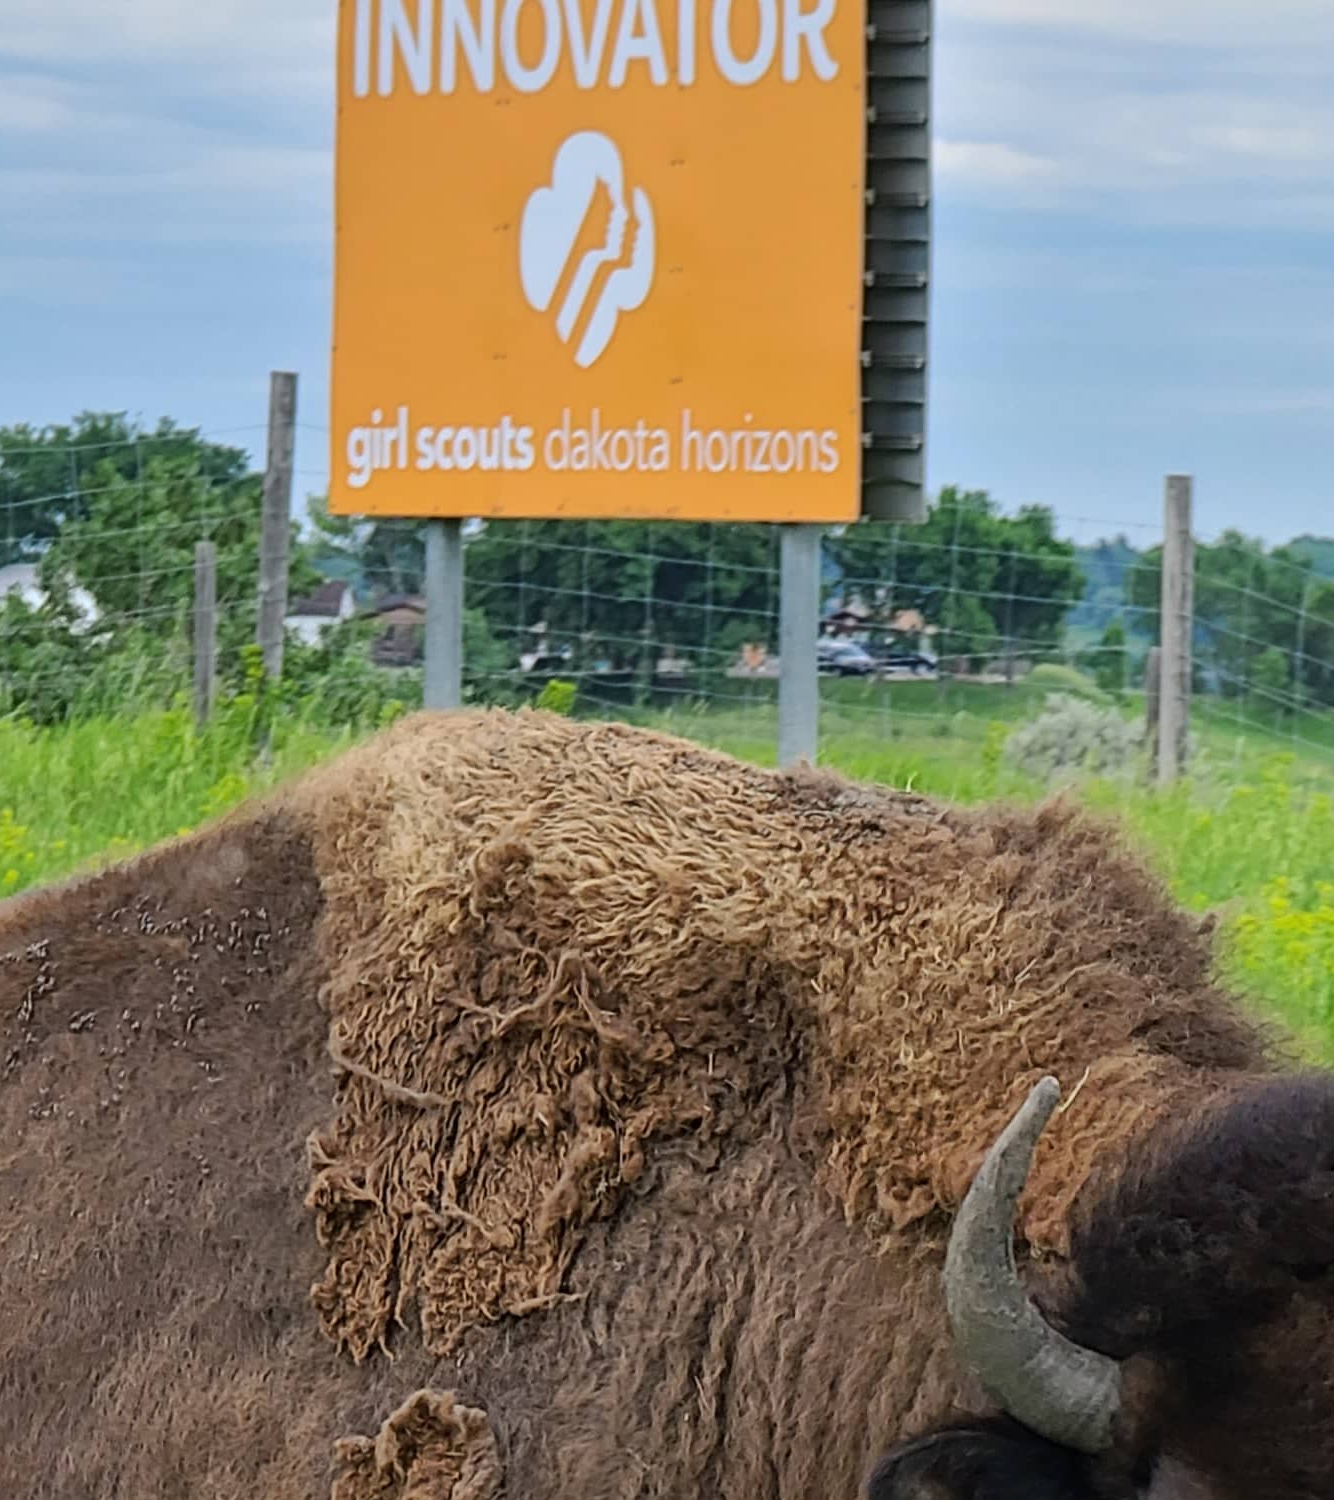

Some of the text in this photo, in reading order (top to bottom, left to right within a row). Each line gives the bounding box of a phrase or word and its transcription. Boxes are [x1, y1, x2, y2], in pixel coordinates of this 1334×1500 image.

[347, 407, 838, 488] girl scouts dakota horizons
